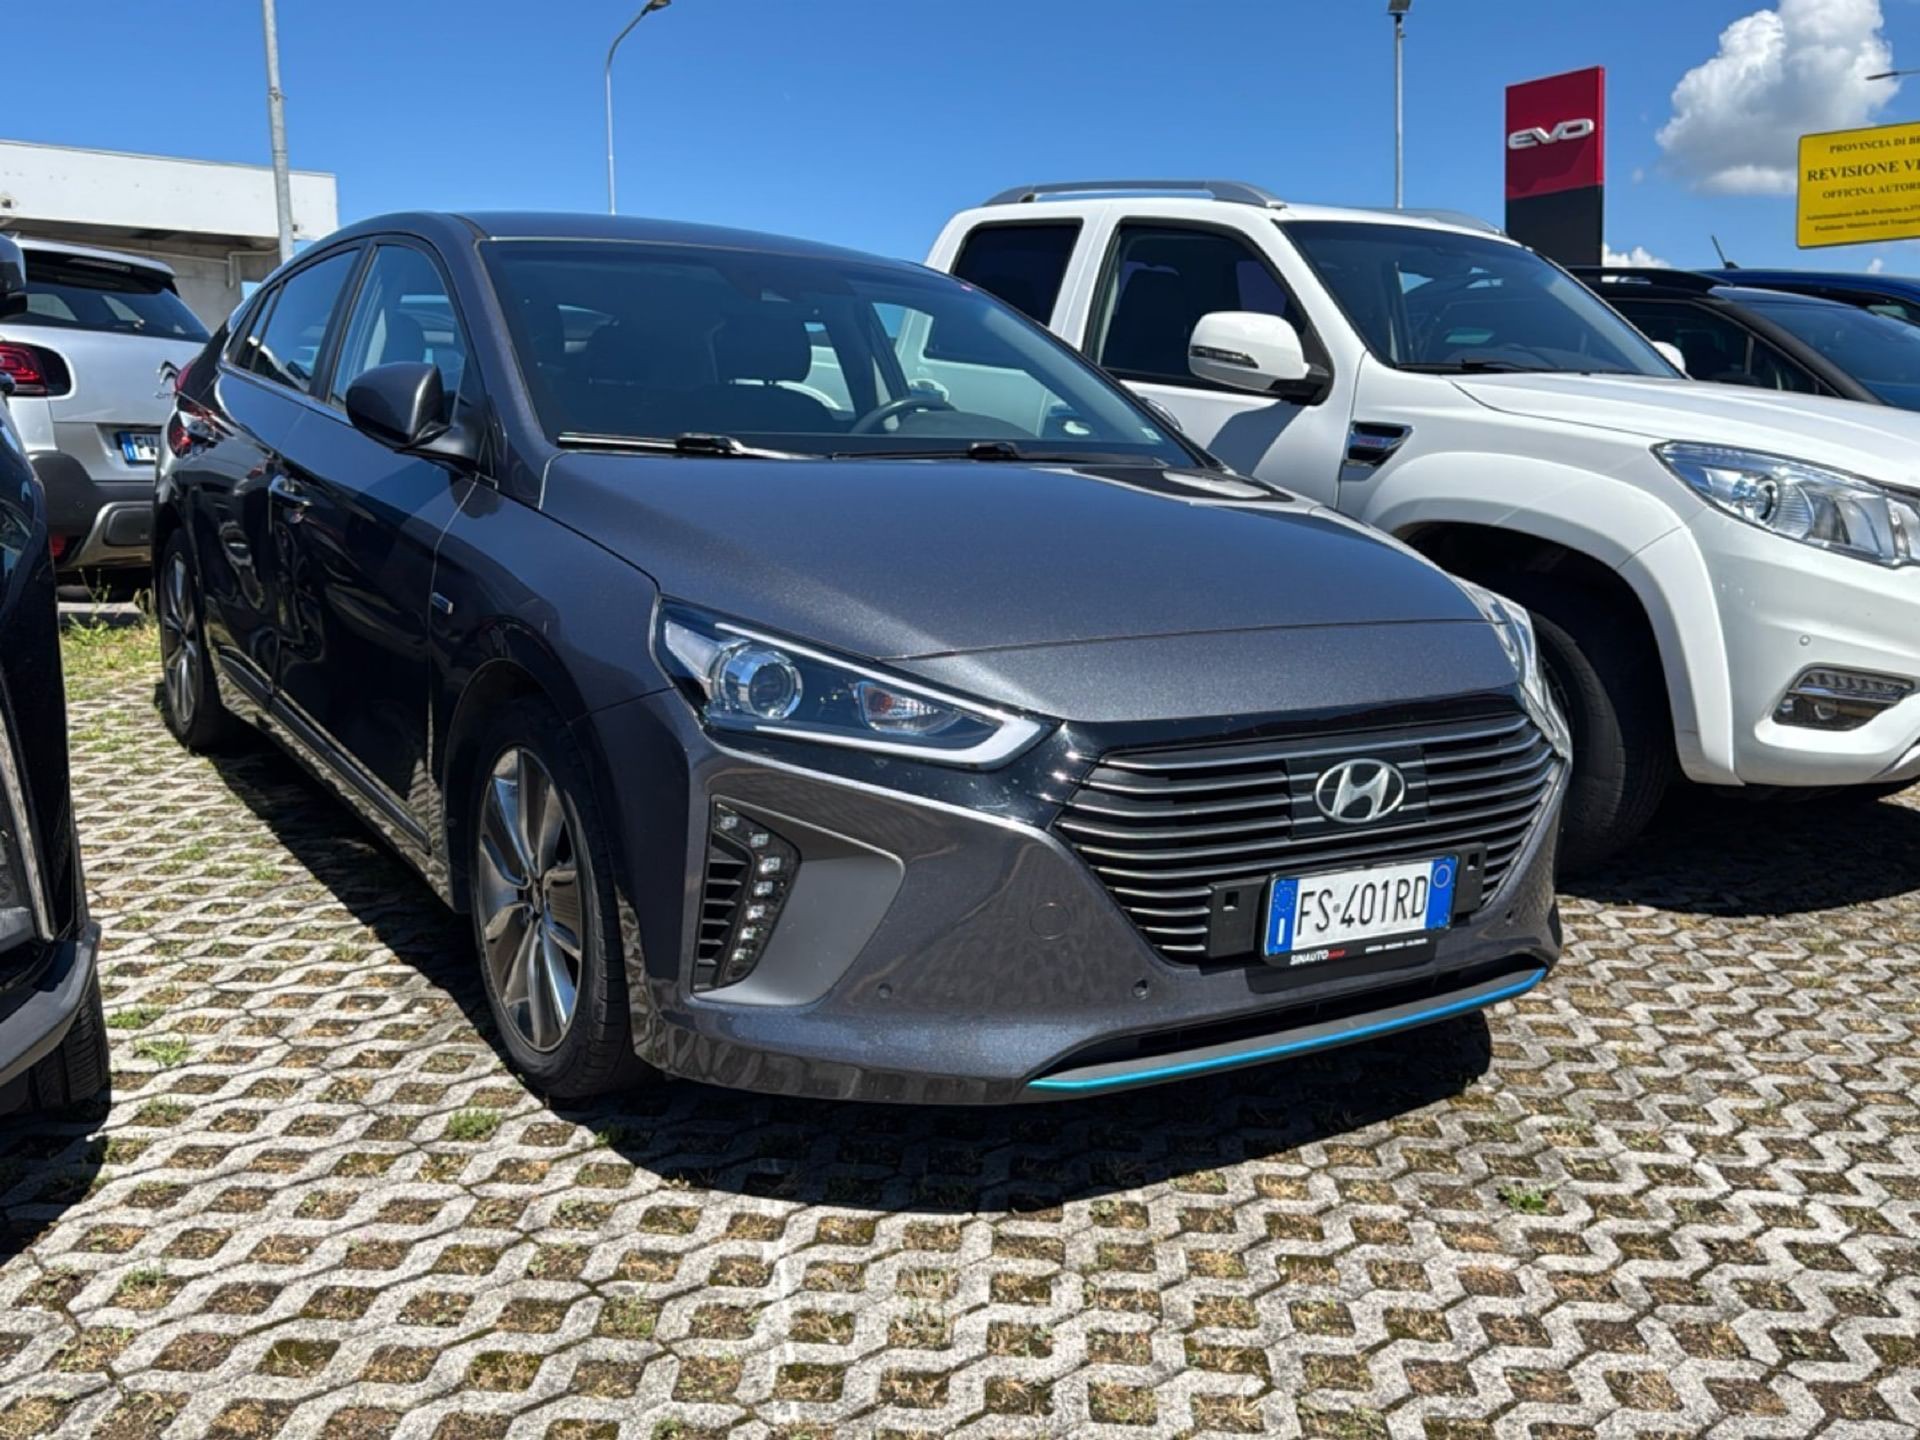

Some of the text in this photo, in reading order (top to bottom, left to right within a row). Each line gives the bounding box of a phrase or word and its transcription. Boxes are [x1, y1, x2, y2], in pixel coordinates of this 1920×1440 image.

[1508, 118, 1595, 150] EVO
[1830, 140, 1891, 153] PROVINCIA
[1894, 138, 1905, 146] DI
[1807, 160, 1900, 182] REVISIONE
[1823, 187, 1875, 199] OFFICINA
